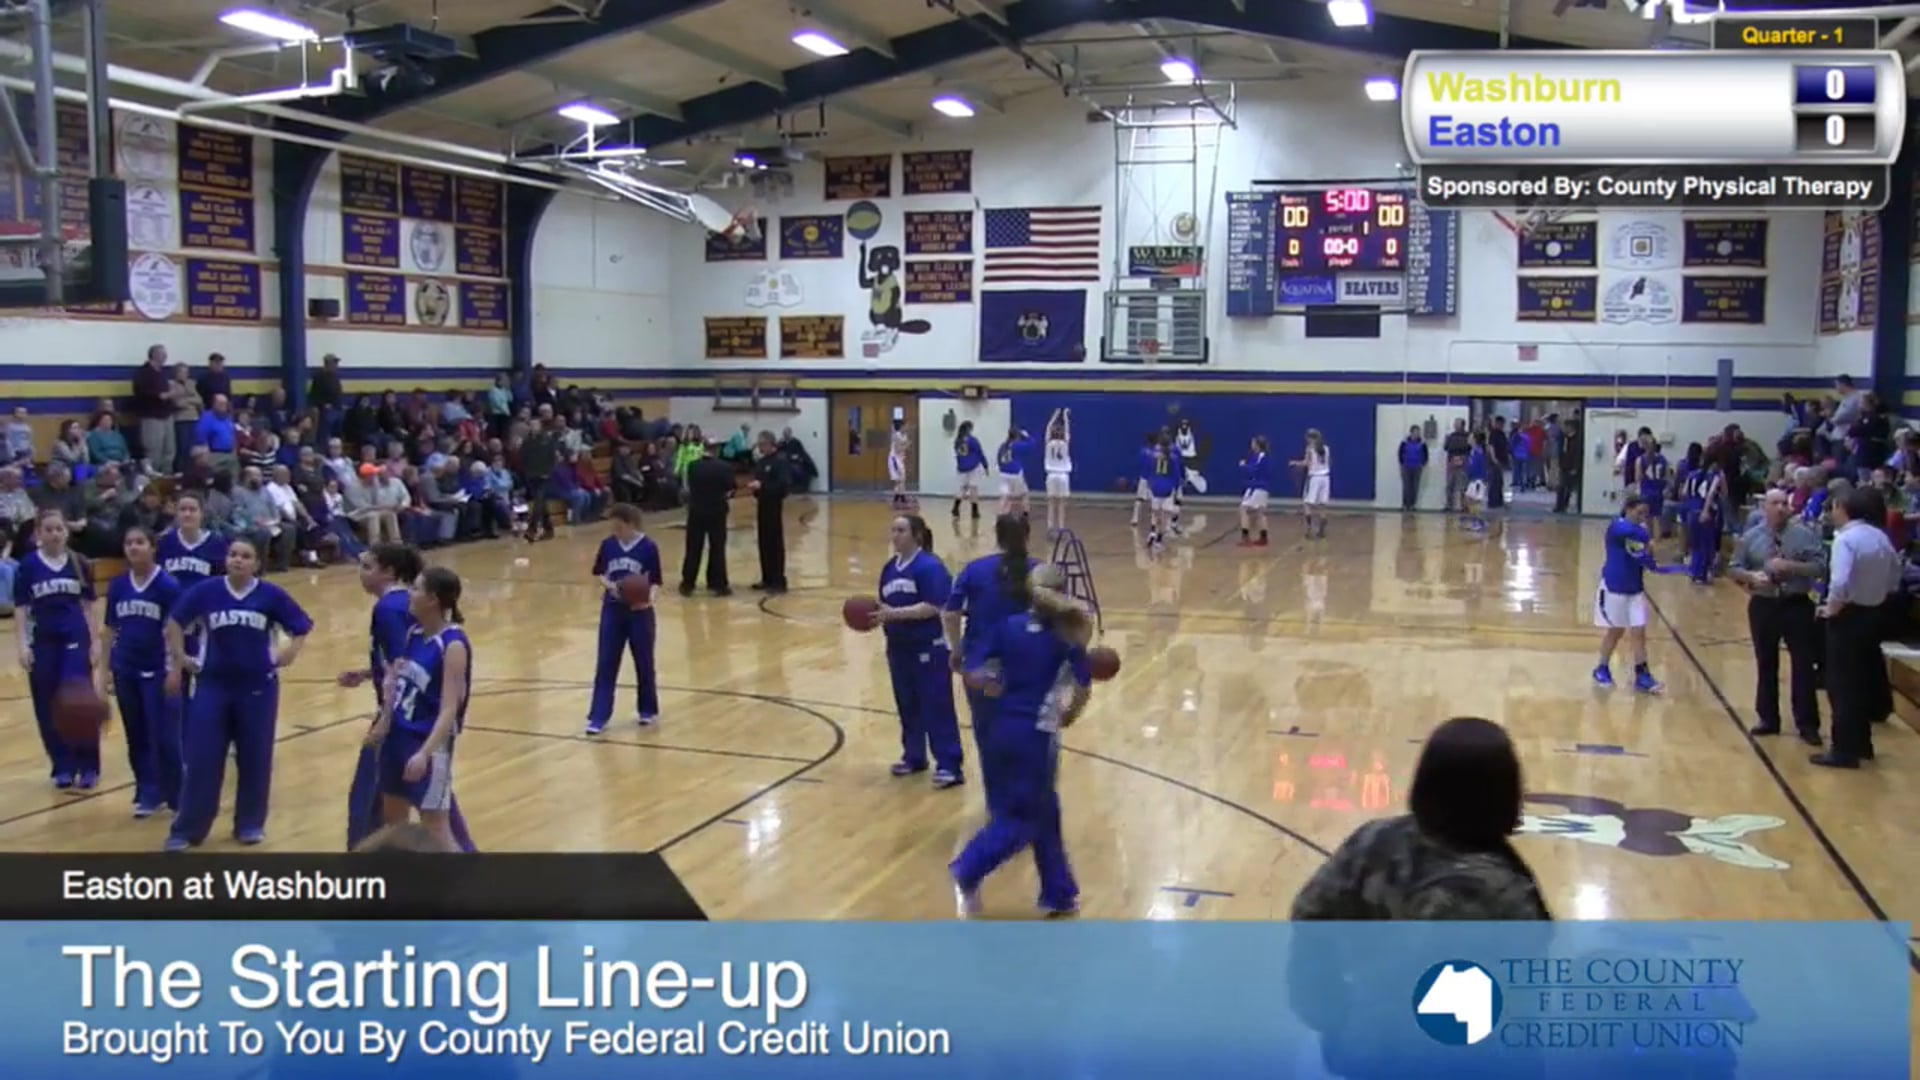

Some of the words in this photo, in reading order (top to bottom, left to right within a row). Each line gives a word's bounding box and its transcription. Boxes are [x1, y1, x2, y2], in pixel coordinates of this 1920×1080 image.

[1325, 190, 1370, 212] 5:00
[1283, 206, 1309, 228] 00
[1377, 205, 1405, 227] 00
[1288, 239, 1300, 256] 0
[1385, 238, 1398, 256] 0
[1344, 280, 1400, 297] BEAVERS
[31, 577, 82, 600] EASTON
[115, 599, 161, 620] EASTON
[208, 610, 268, 631] EASTON
